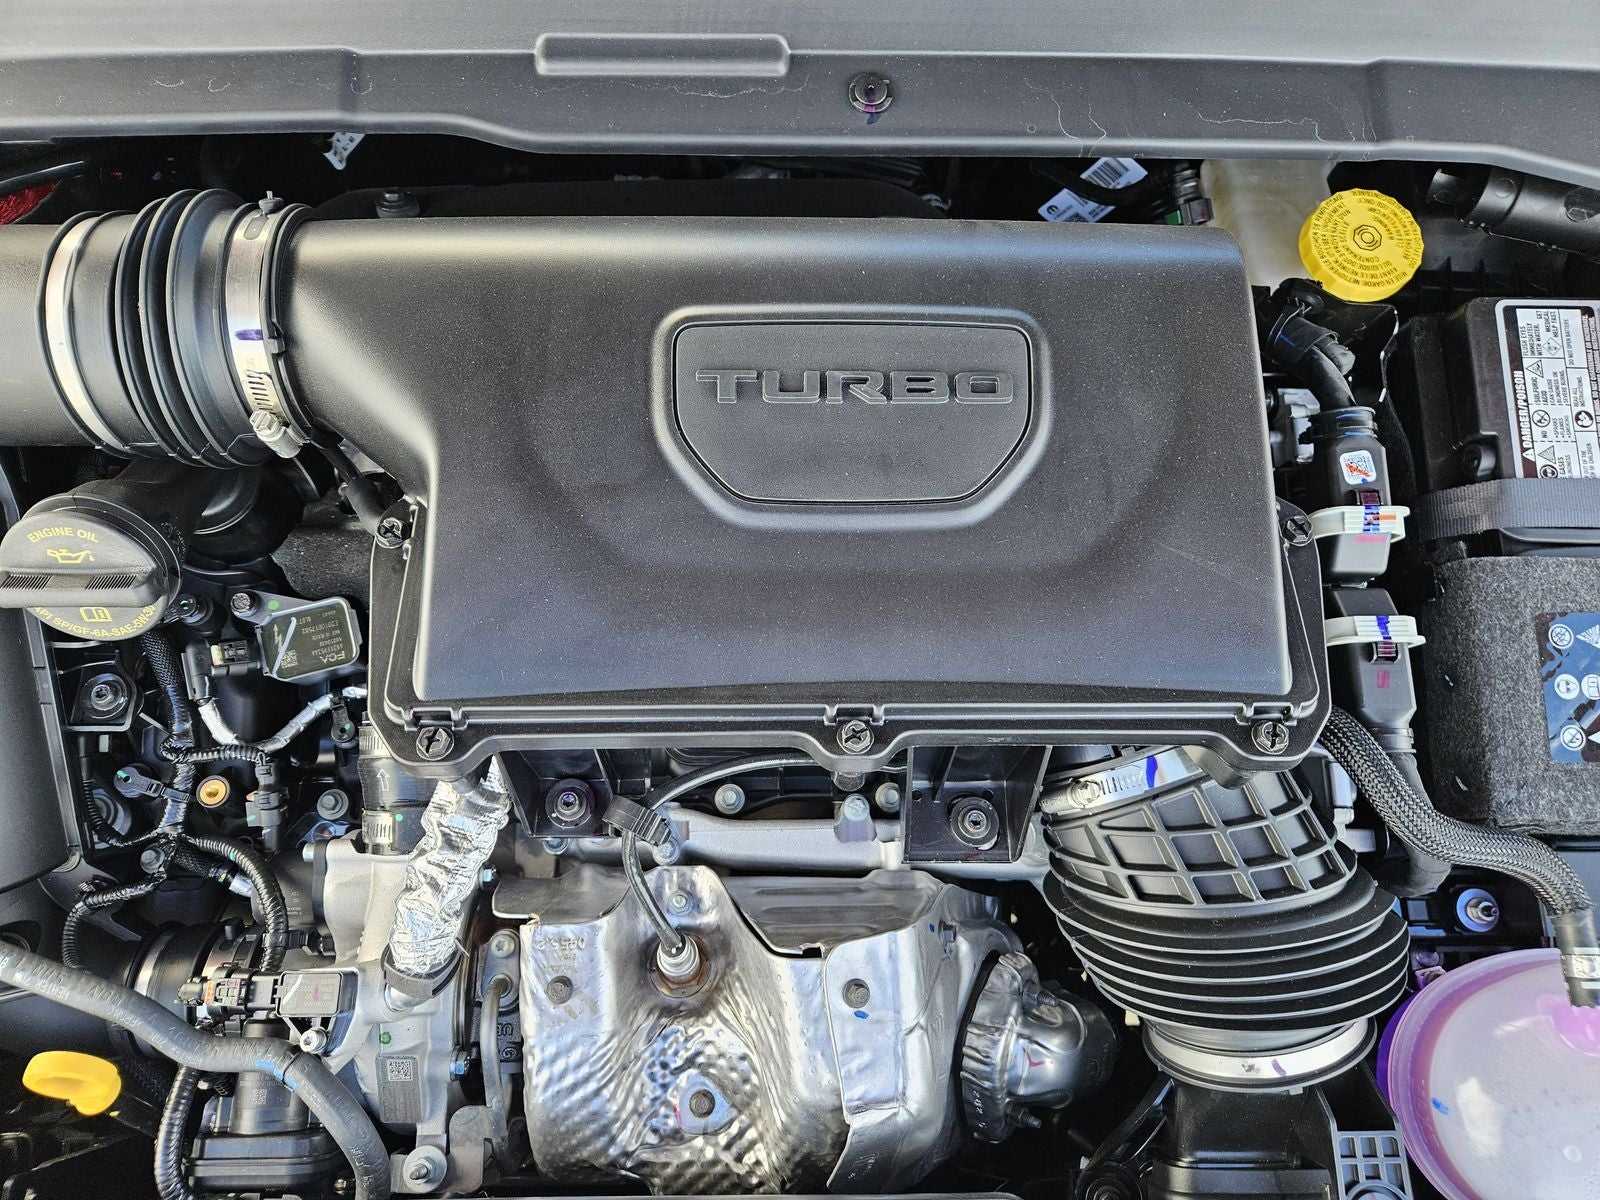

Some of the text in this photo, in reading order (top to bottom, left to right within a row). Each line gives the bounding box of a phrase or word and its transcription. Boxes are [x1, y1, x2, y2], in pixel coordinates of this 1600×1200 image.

[1542, 310, 1551, 333] MEDICAL
[1527, 323, 1536, 357] IMMEDIATELY
[1551, 325, 1559, 338] HELP
[1519, 326, 1529, 357] FLUSH EYES
[1535, 342, 1543, 356] WITH
[1569, 358, 1575, 367] DO
[695, 369, 1014, 404] TURBO
[1531, 376, 1540, 403] SULFURIC
[1553, 379, 1562, 404] BLINDNESS
[1561, 387, 1569, 404] SEVERE
[1541, 390, 1549, 403] ACID
[1572, 395, 1580, 408] READ
[1513, 371, 1534, 449] DANGER/POISON
[1541, 430, 1548, 439] NO
[1586, 443, 1595, 465] CHILDREN
[1557, 456, 1566, 475] GASES
[27, 527, 99, 544] ENGINE OIL
[320, 651, 345, 664] FCA
